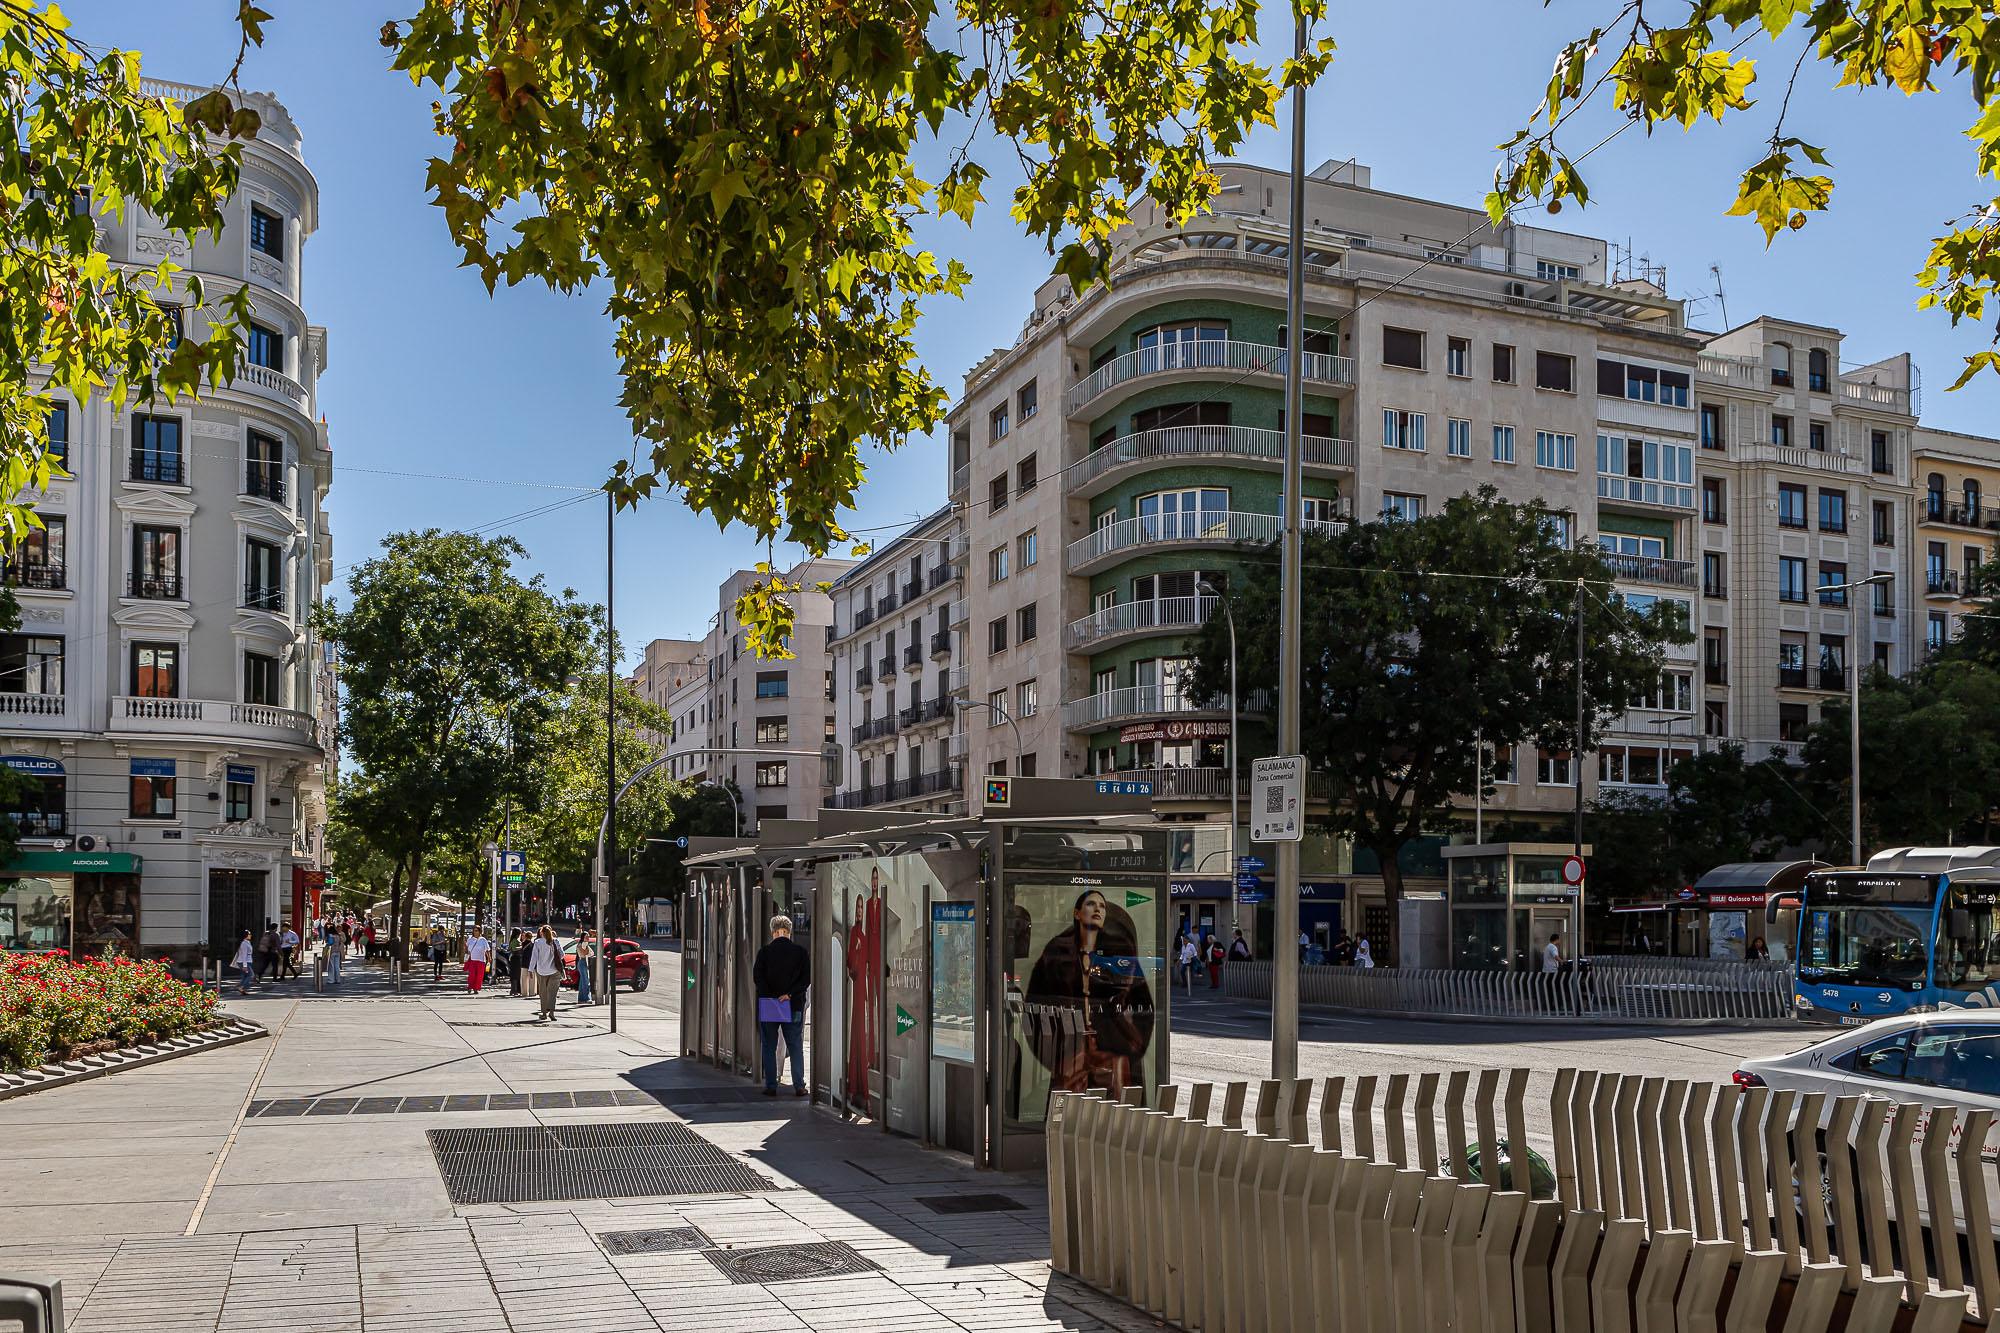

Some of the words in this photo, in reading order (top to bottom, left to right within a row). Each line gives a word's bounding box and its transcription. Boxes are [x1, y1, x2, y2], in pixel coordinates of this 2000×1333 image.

[1193, 723, 1204, 735] 914
[1257, 761, 1296, 772] SALAMANCA
[1270, 772, 1294, 780] Comercial
[1113, 785, 1120, 793] E4
[1127, 783, 1135, 792] 61
[1140, 785, 1149, 793] 26
[506, 855, 520, 871] P
[1170, 884, 1194, 894] BVA
[892, 957, 923, 972] VUELVE
[891, 974, 900, 988] LA
[904, 975, 920, 989] MOD
[1823, 989, 1838, 997] 5478
[1116, 1004, 1154, 1014] MODA
[1809, 1052, 1823, 1068] M
